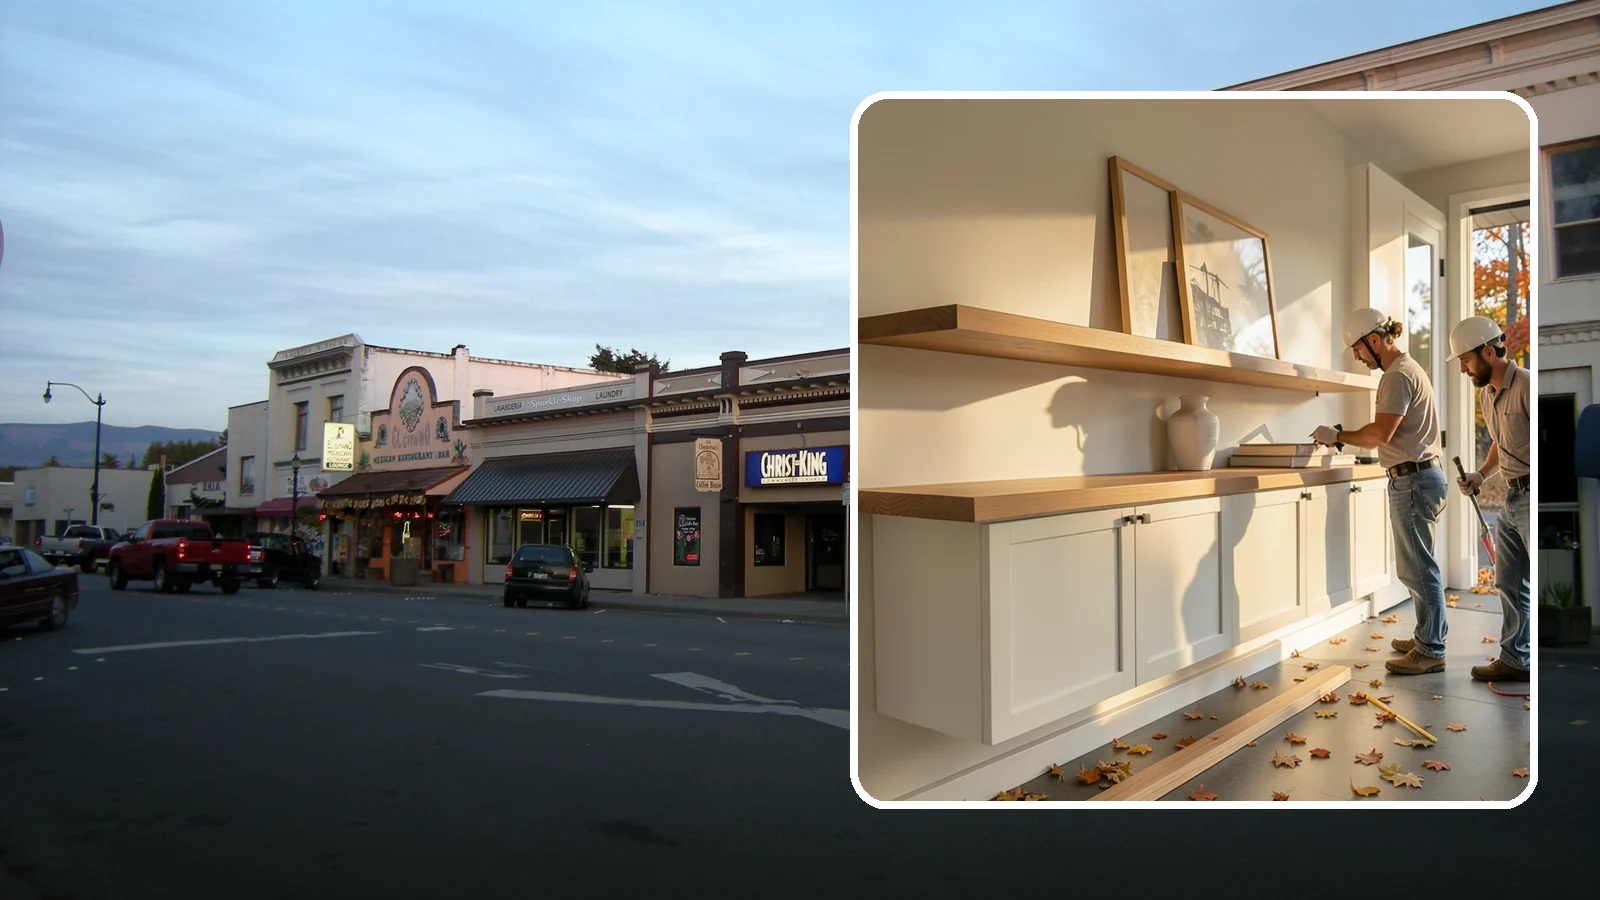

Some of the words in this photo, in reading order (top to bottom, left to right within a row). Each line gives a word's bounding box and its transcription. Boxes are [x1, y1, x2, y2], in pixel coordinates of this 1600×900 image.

[595, 389, 623, 400] LAUNDRY
[493, 402, 522, 413] LAVANDERIA
[530, 397, 560, 409] Sparkle
[561, 394, 583, 406] Shop
[373, 454, 396, 465] MEXICAN
[397, 451, 434, 462] RESTAURANT
[437, 450, 450, 459] BAR
[761, 452, 797, 478] CHRIST
[799, 450, 827, 476] KING
[697, 480, 709, 488] Coffee
[710, 480, 722, 488] House
